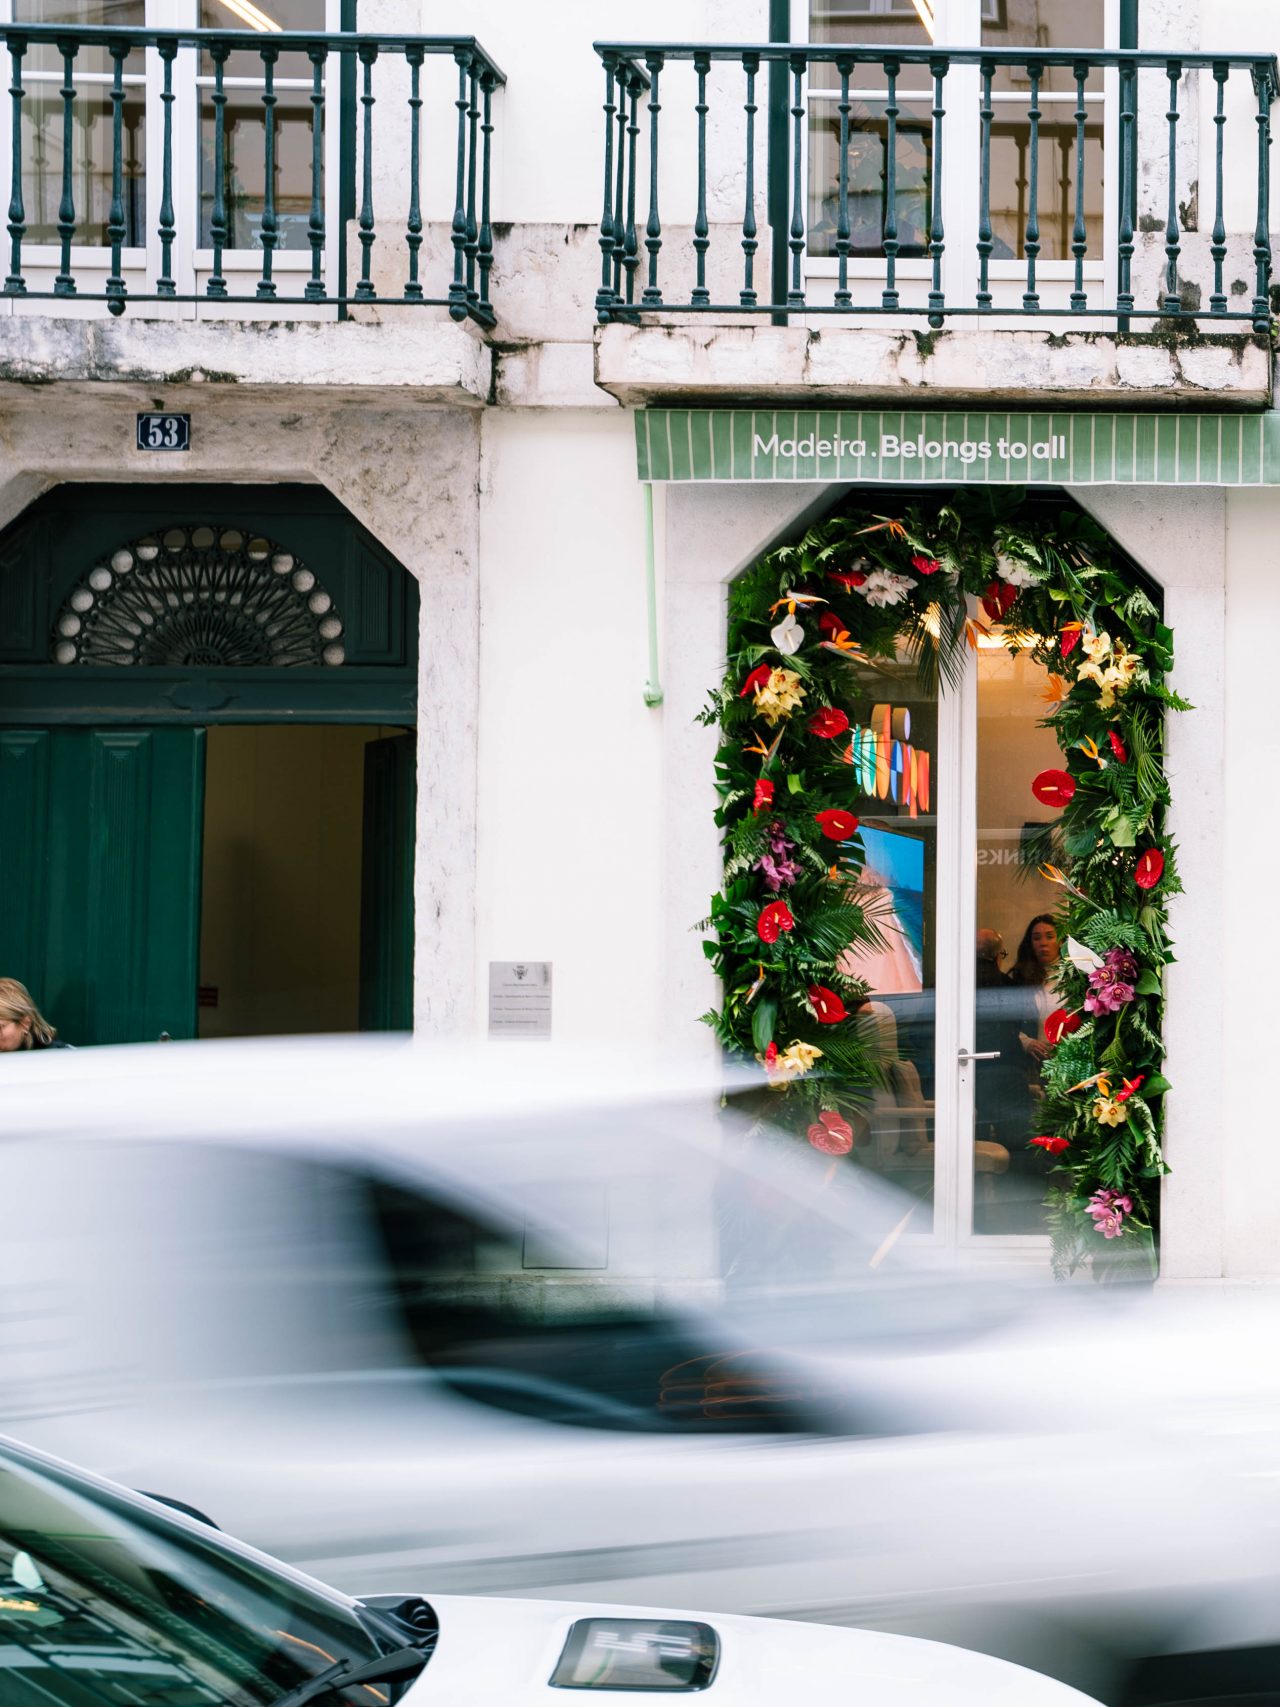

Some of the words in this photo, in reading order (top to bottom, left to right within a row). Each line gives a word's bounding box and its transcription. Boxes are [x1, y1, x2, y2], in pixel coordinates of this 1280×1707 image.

[148, 417, 179, 447] 53
[997, 436, 1028, 460] to
[1032, 435, 1066, 460] all
